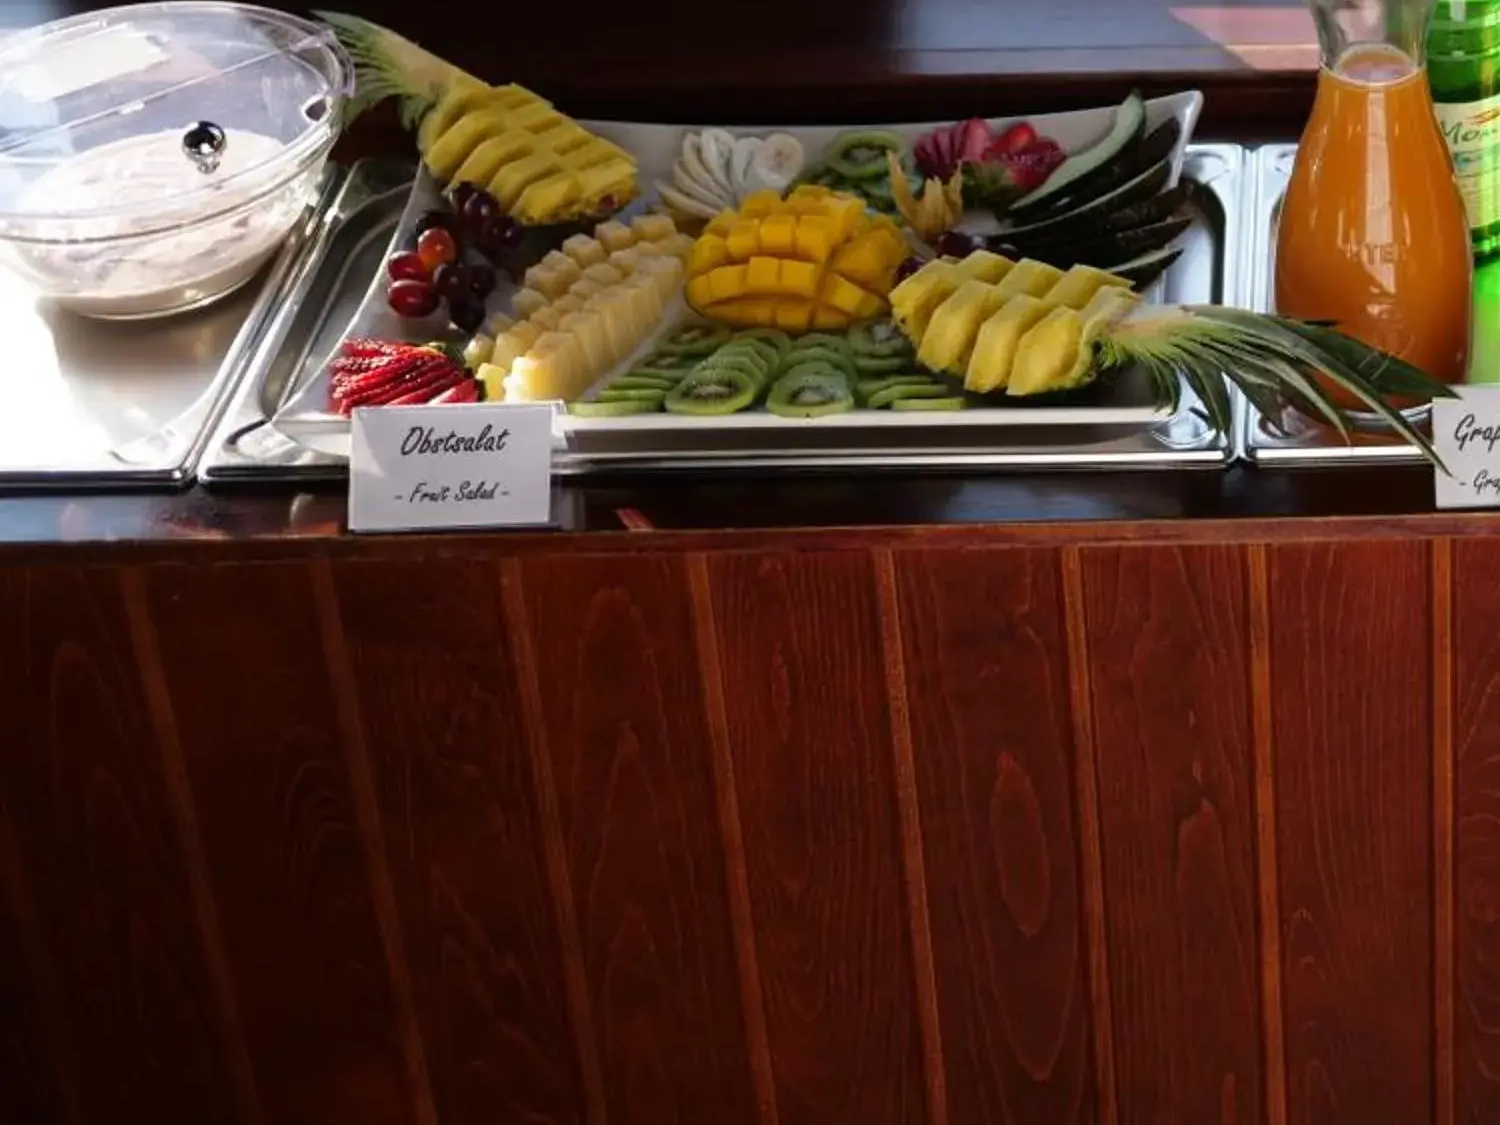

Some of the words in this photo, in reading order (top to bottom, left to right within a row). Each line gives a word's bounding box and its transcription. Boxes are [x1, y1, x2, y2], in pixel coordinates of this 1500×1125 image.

[400, 424, 511, 457] Obstsalat
[409, 481, 450, 503] Fruit
[454, 480, 500, 503] Salad
